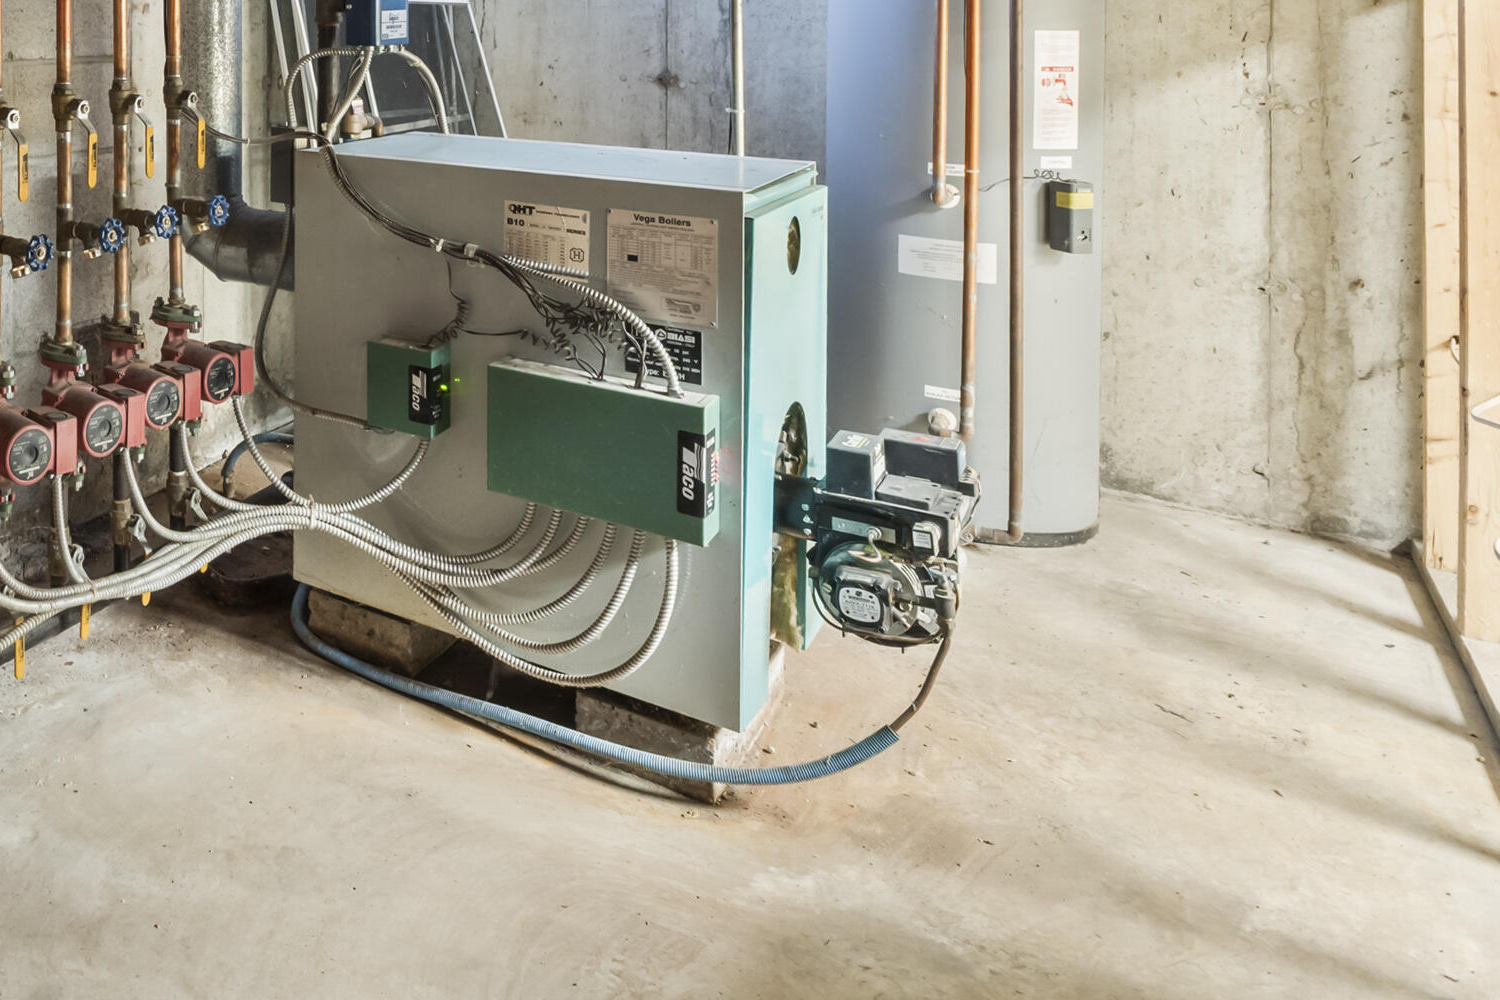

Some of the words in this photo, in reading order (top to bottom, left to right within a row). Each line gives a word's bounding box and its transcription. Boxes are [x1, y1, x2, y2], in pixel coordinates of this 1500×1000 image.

[508, 204, 536, 216] QHT
[507, 217, 525, 227] B10
[633, 213, 655, 224] Vega
[658, 216, 691, 227] Boilers
[412, 370, 427, 412] Taco
[682, 442, 705, 501] Taco
